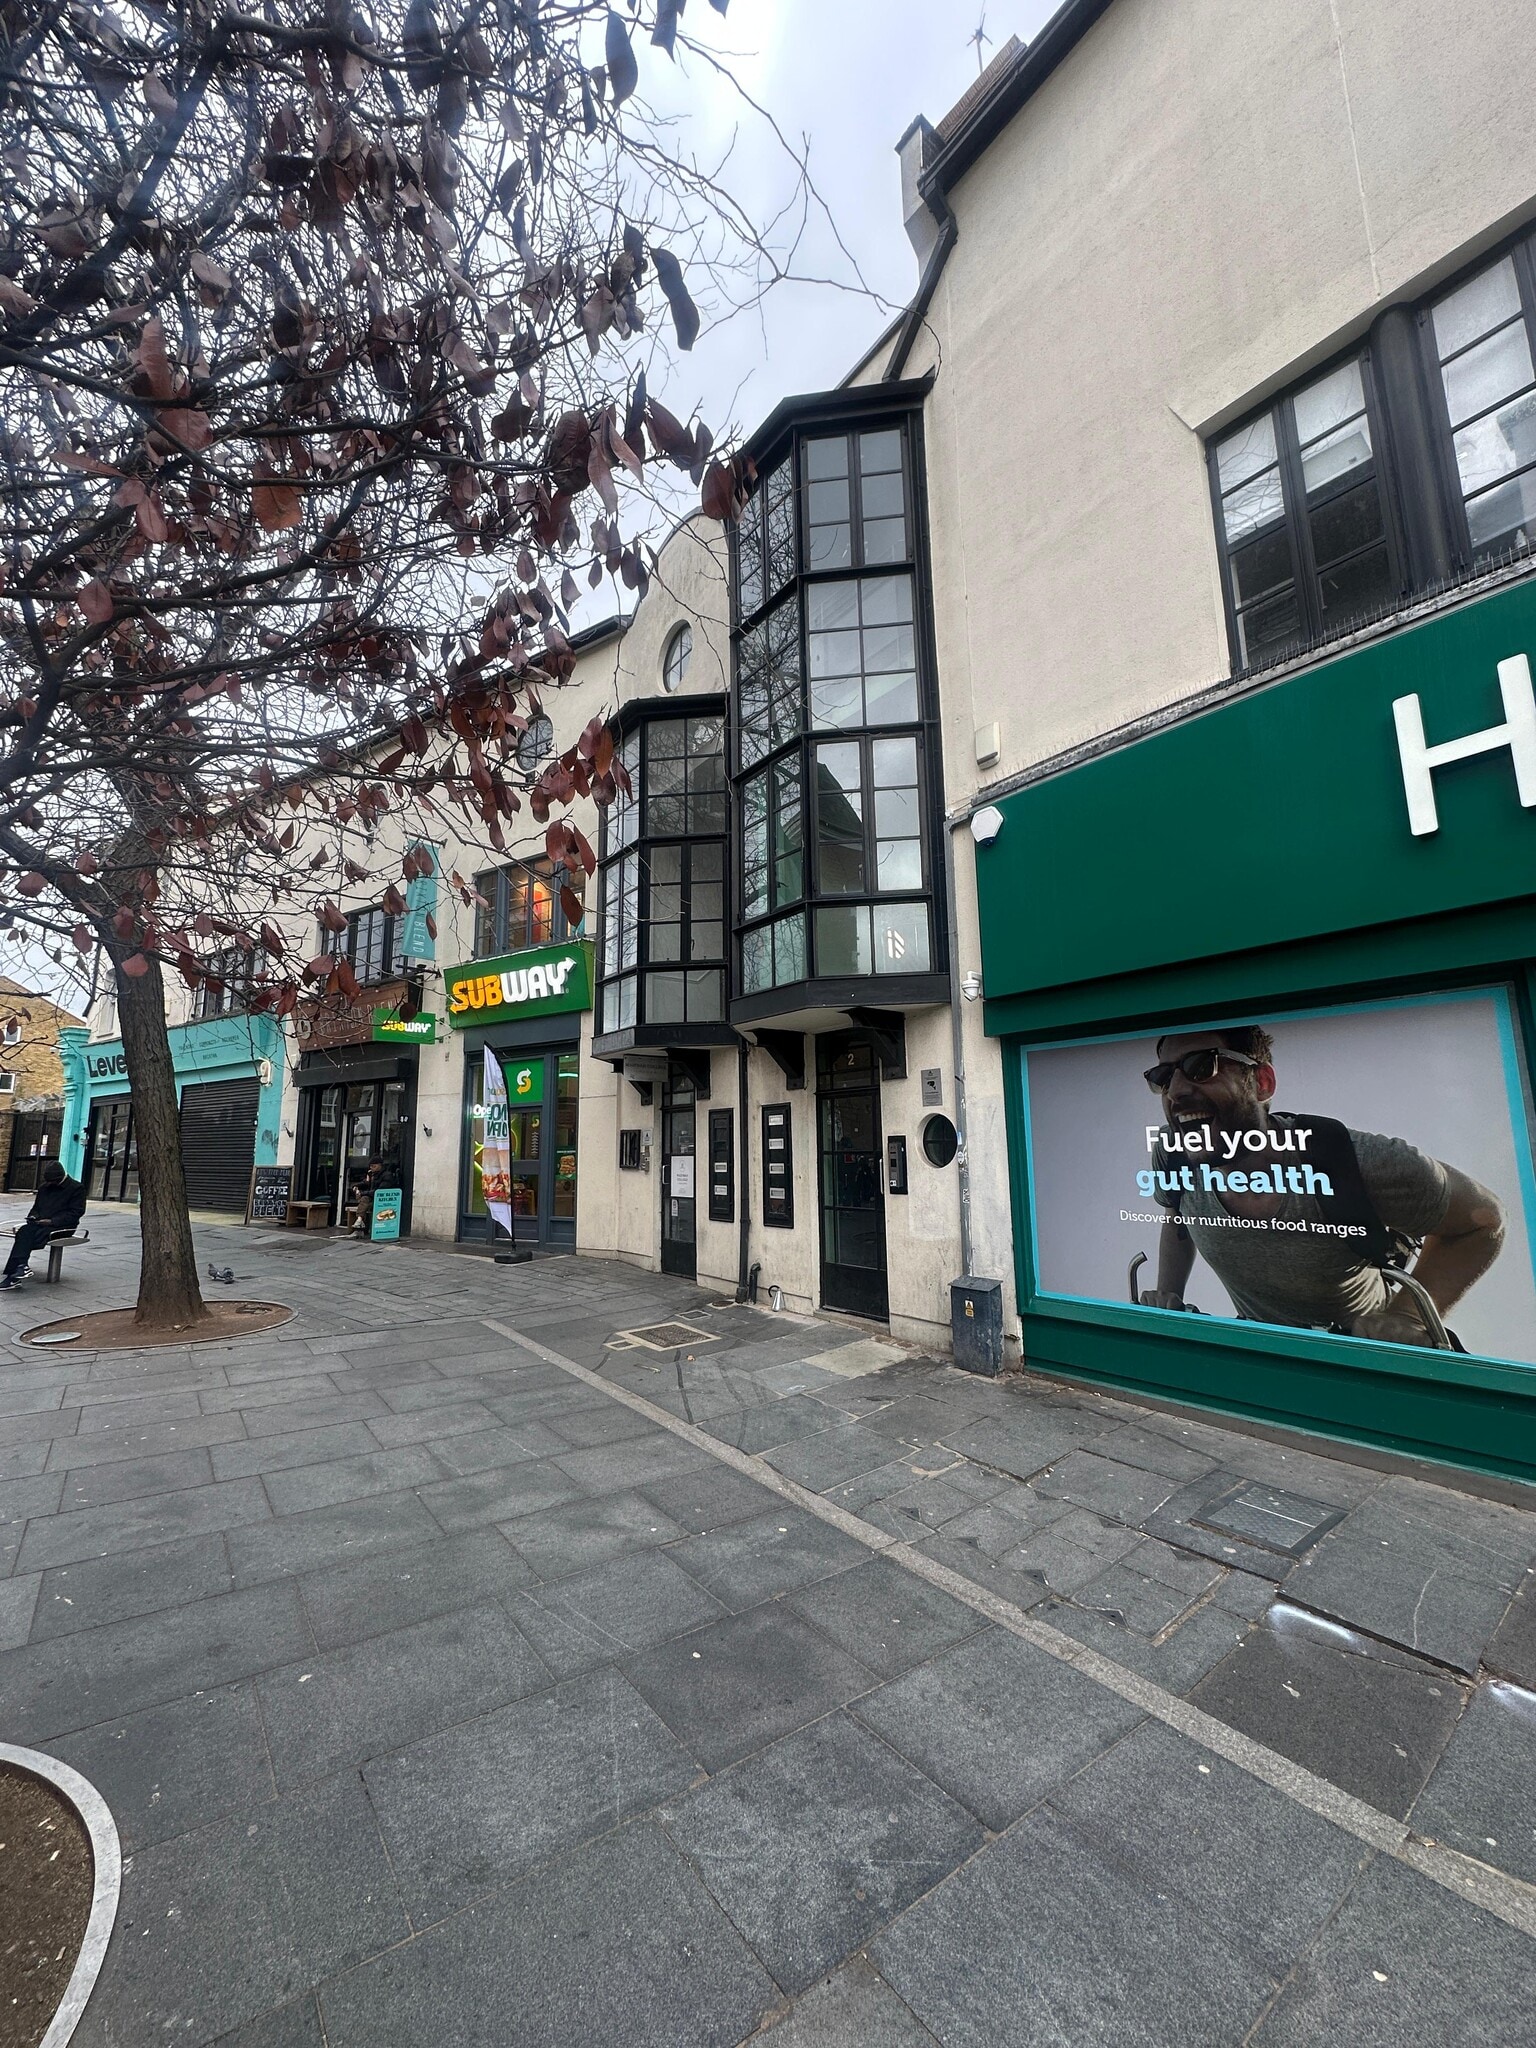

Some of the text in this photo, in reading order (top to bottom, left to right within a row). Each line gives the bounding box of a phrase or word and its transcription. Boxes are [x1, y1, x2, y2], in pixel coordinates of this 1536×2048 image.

[413, 921, 426, 953] BLEND
[450, 957, 577, 1014] SUBWAY
[381, 1020, 432, 1033] SUBWAY
[87, 1055, 127, 1078] Leve
[847, 1053, 855, 1066] 2
[473, 1104, 492, 1116] Ope
[1145, 1124, 1313, 1160] Fuel your
[1135, 1163, 1335, 1197] gut health
[1119, 1210, 1367, 1239] Discover our nutritious food ranges
